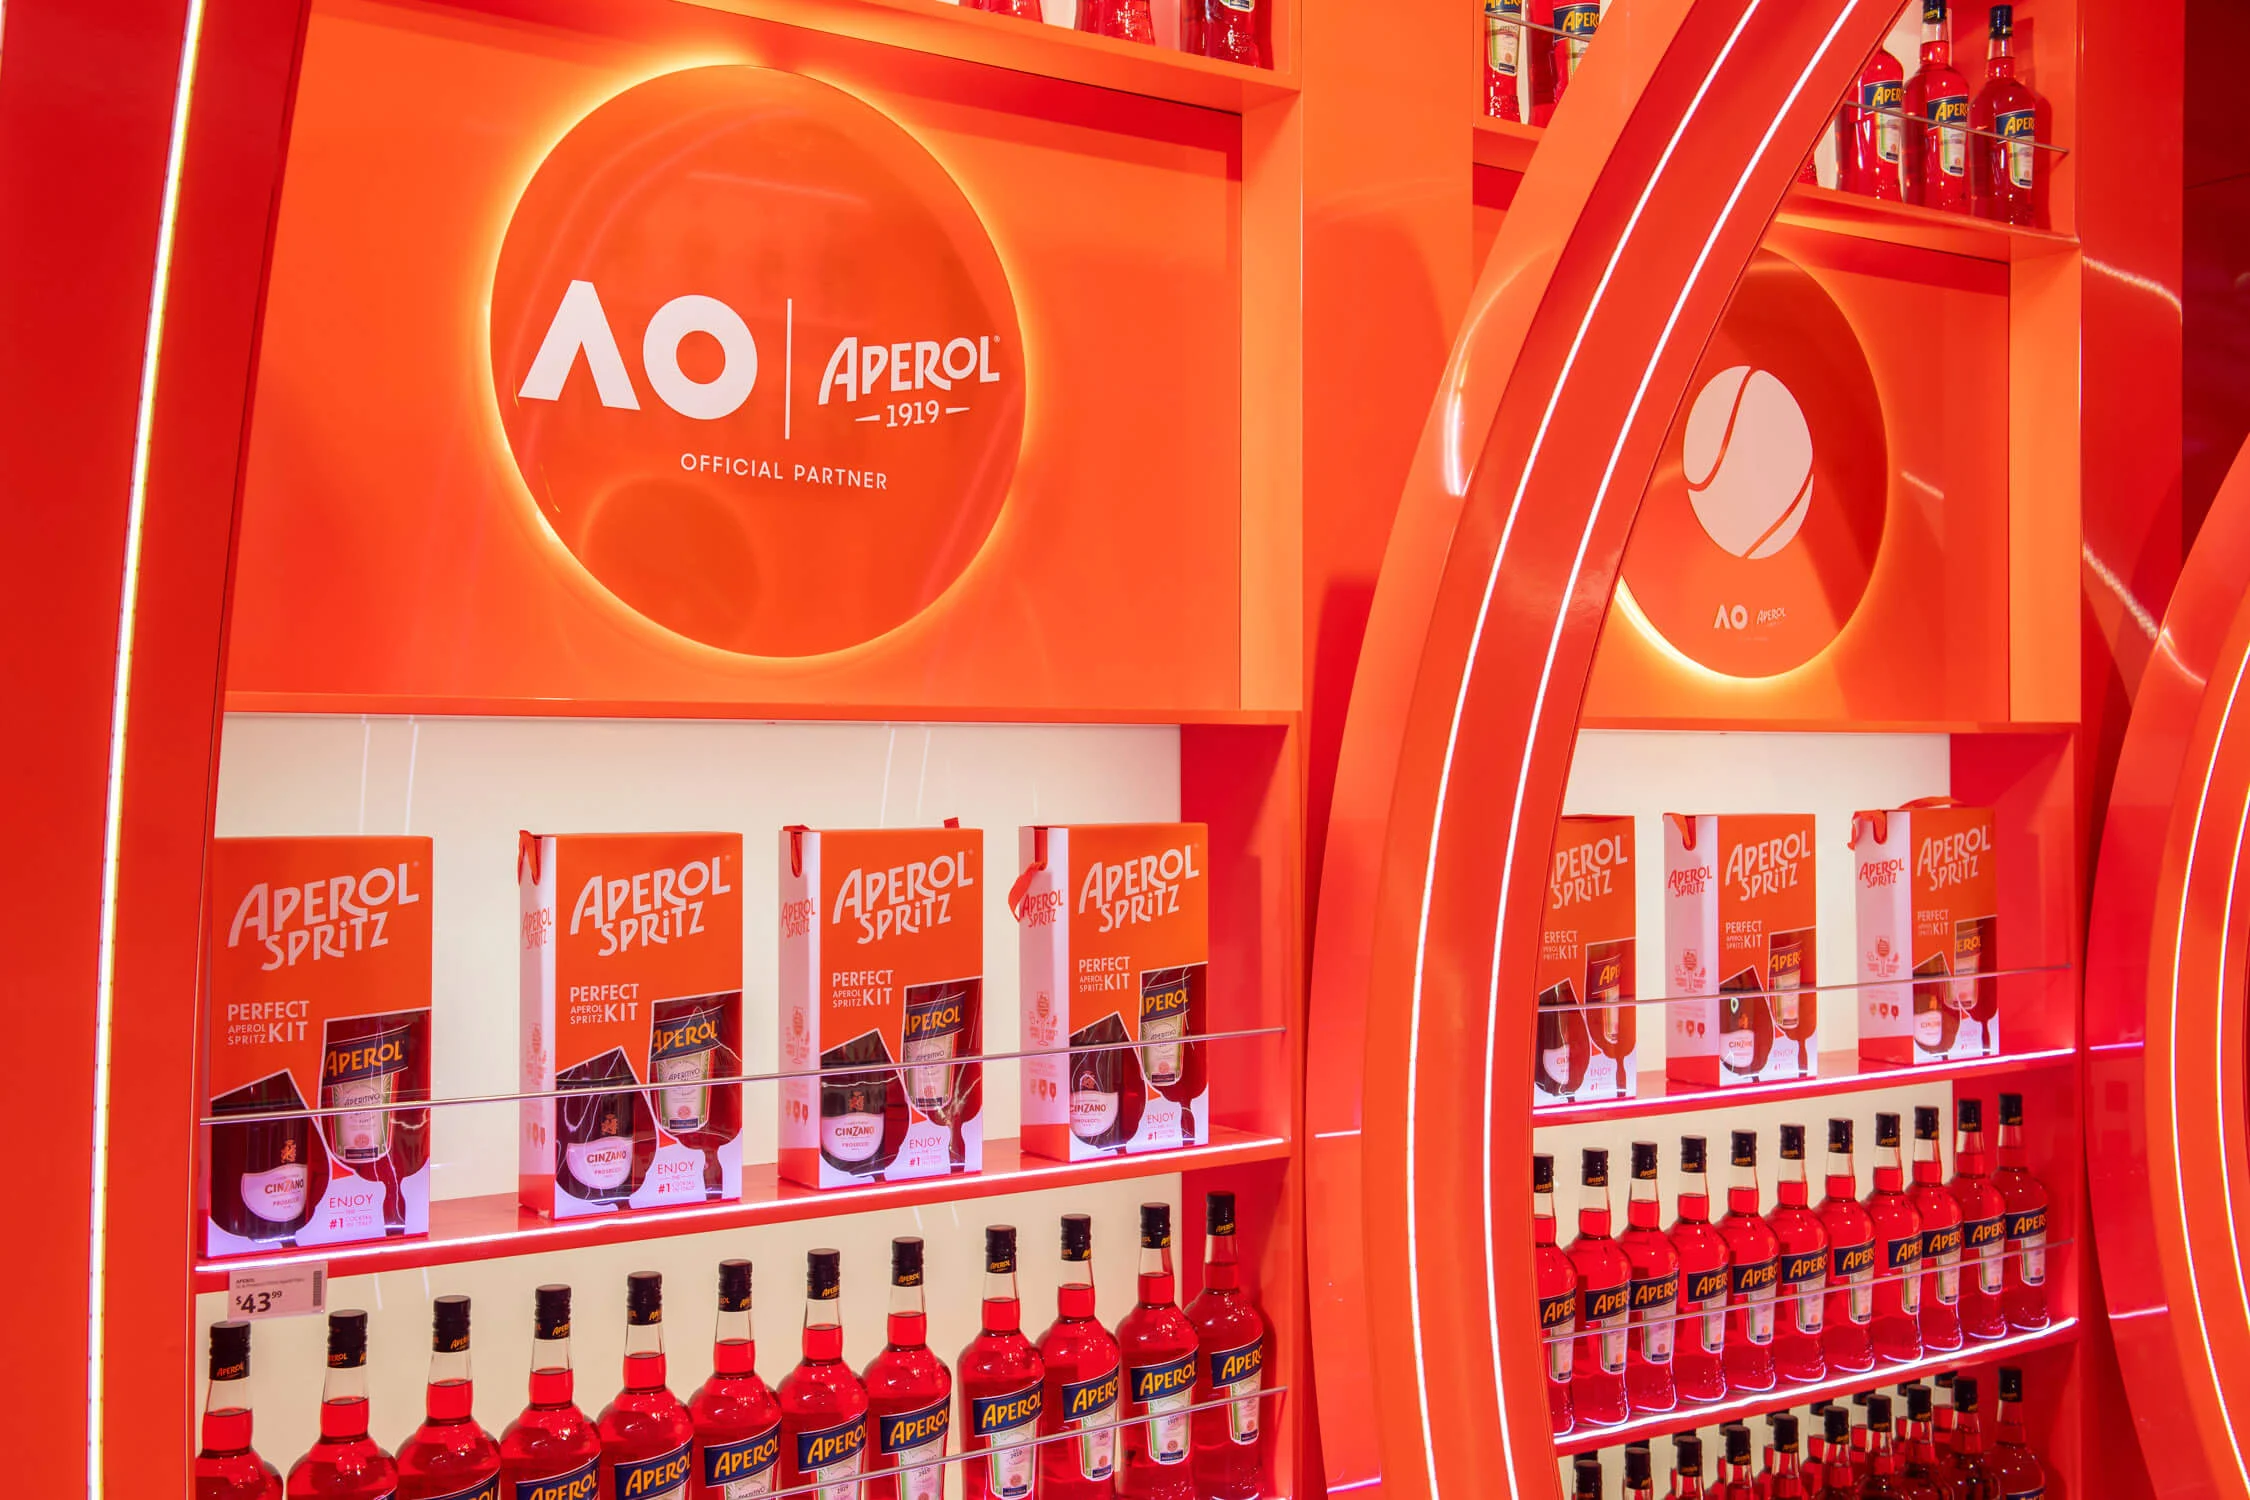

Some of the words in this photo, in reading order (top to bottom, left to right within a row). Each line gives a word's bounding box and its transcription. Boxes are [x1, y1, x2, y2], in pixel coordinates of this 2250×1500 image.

[519, 280, 758, 420] AO
[818, 336, 999, 405] APEROL
[886, 401, 939, 427] 1919
[680, 453, 783, 480] OFFICIAL
[794, 464, 887, 490] PARTNER
[1714, 605, 1748, 630] AO
[1725, 830, 1811, 886] APEROL
[1917, 825, 1991, 877] APEROL
[1668, 866, 1712, 888] APEROL
[1859, 858, 1904, 880] APEROL
[832, 852, 973, 924] APEROL
[1079, 845, 1199, 915] APEROL
[570, 857, 731, 935] APEROL
[1022, 890, 1063, 917] APEROL
[228, 863, 419, 948] APEROL
[1917, 909, 1949, 921] PERFECT
[1726, 920, 1762, 934] PERFECT
[1933, 922, 1948, 936] KIT
[1544, 931, 1578, 944] ERFECT
[1744, 934, 1762, 948] KIT
[1559, 945, 1578, 960] KIT
[1079, 956, 1130, 972] PERFECT
[832, 970, 893, 987] PERFECT
[1105, 973, 1130, 990] KIT
[570, 984, 639, 1002] PERFECT
[833, 990, 861, 998] APEROL
[863, 987, 893, 1006] KIT
[228, 1001, 309, 1021] PERFECT
[571, 1004, 603, 1014] APEROL
[604, 1002, 638, 1022] KIT
[833, 999, 861, 1008] SPRITZ
[571, 1014, 603, 1025] SPRITZ
[228, 1024, 266, 1034] APEROL
[268, 1021, 308, 1043] KIT
[228, 1035, 266, 1045] SPRITZ
[1147, 1112, 1175, 1124] ENJOY
[835, 1126, 875, 1136] CINZANO
[909, 1136, 942, 1149] ENJOY
[586, 1151, 627, 1163] CINZANO
[657, 1161, 695, 1174] ENJOY
[265, 1178, 304, 1194] CINZANO
[658, 1183, 671, 1194] #1
[329, 1194, 373, 1209] ENJOY
[329, 1217, 344, 1230] #1
[216, 1362, 244, 1377] APEROL
[1140, 1360, 1195, 1396] APEROL
[982, 1390, 1041, 1428] APEROL
[889, 1408, 950, 1446] APEROL
[807, 1421, 866, 1464] APEROL
[714, 1436, 779, 1479] APEROL
[625, 1452, 691, 1497] APEROL
